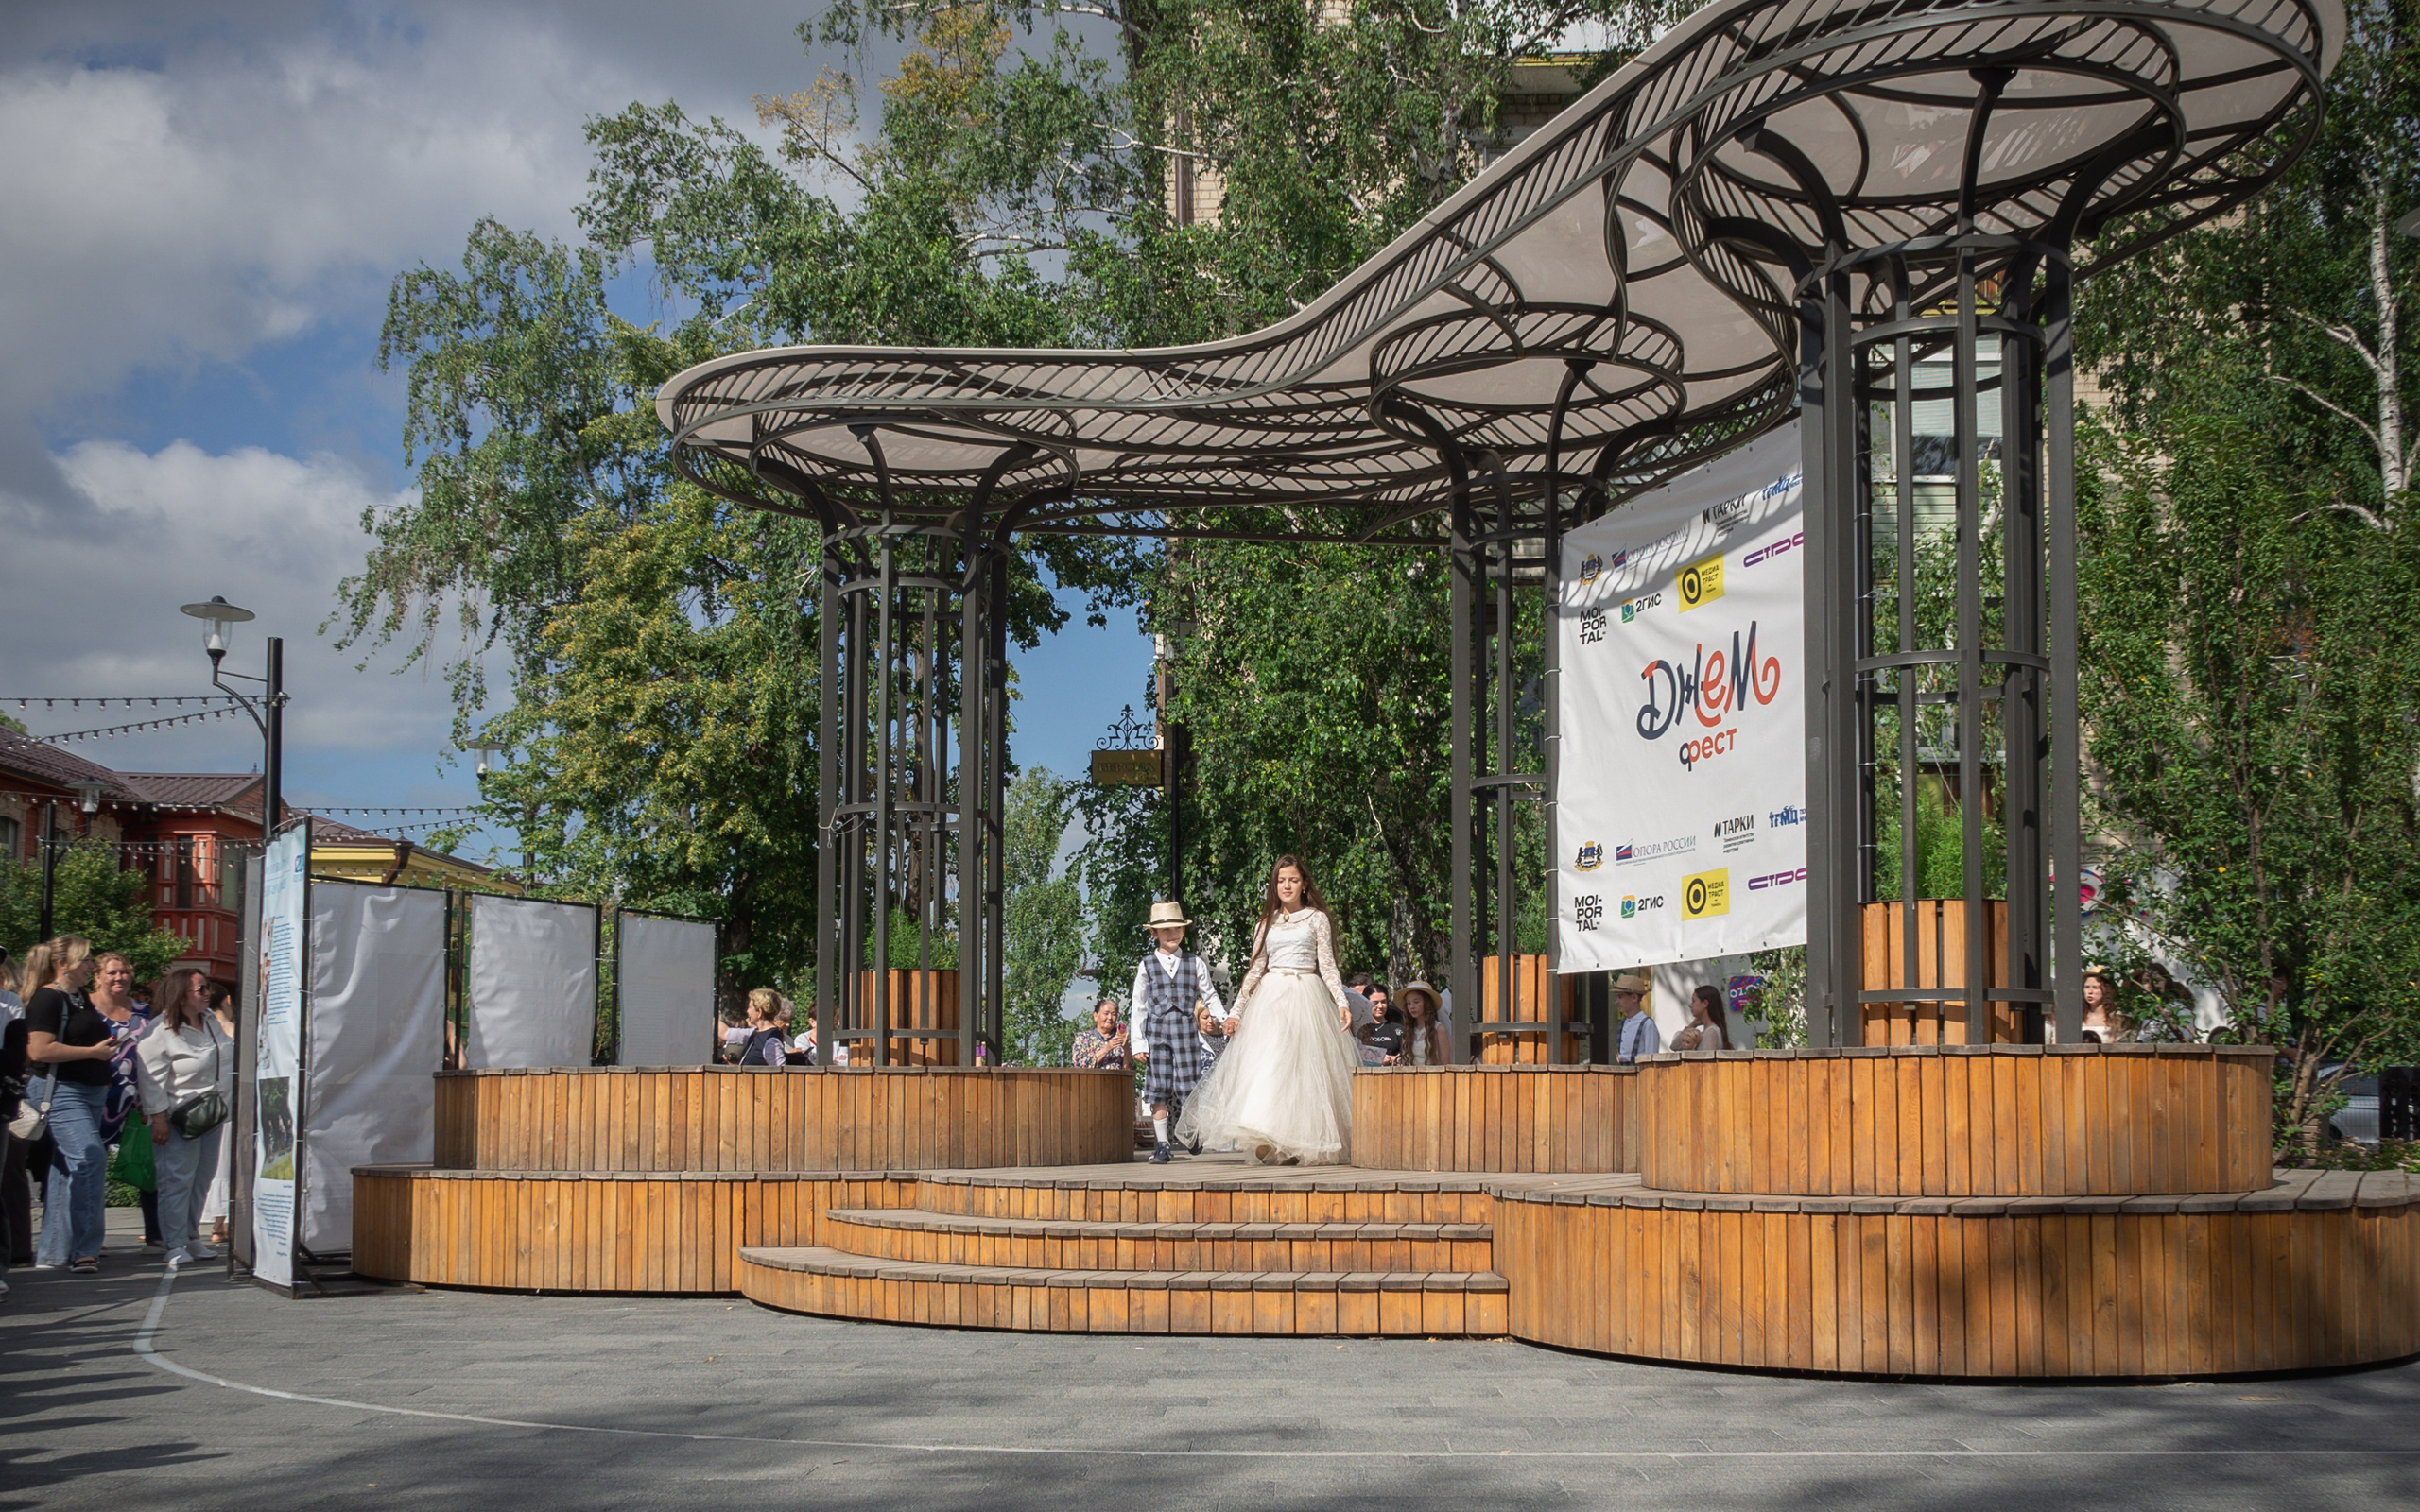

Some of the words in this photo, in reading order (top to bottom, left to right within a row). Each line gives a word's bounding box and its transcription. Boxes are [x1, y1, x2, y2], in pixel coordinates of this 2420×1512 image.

[1712, 493, 1747, 519] ТАРКИ
[1627, 542, 1654, 561] ОПОРА
[1655, 526, 1687, 549] РОССИИ
[1636, 593, 1662, 612] 2ГИС
[1582, 616, 1606, 633] POR
[1679, 728, 1737, 772] фест
[1722, 814, 1754, 835] ТАРКИ
[1634, 843, 1662, 858] ОПОРА
[1663, 835, 1696, 852] РОССИИ
[1577, 906, 1602, 919] POR
[1638, 895, 1664, 911] 2ГИС
